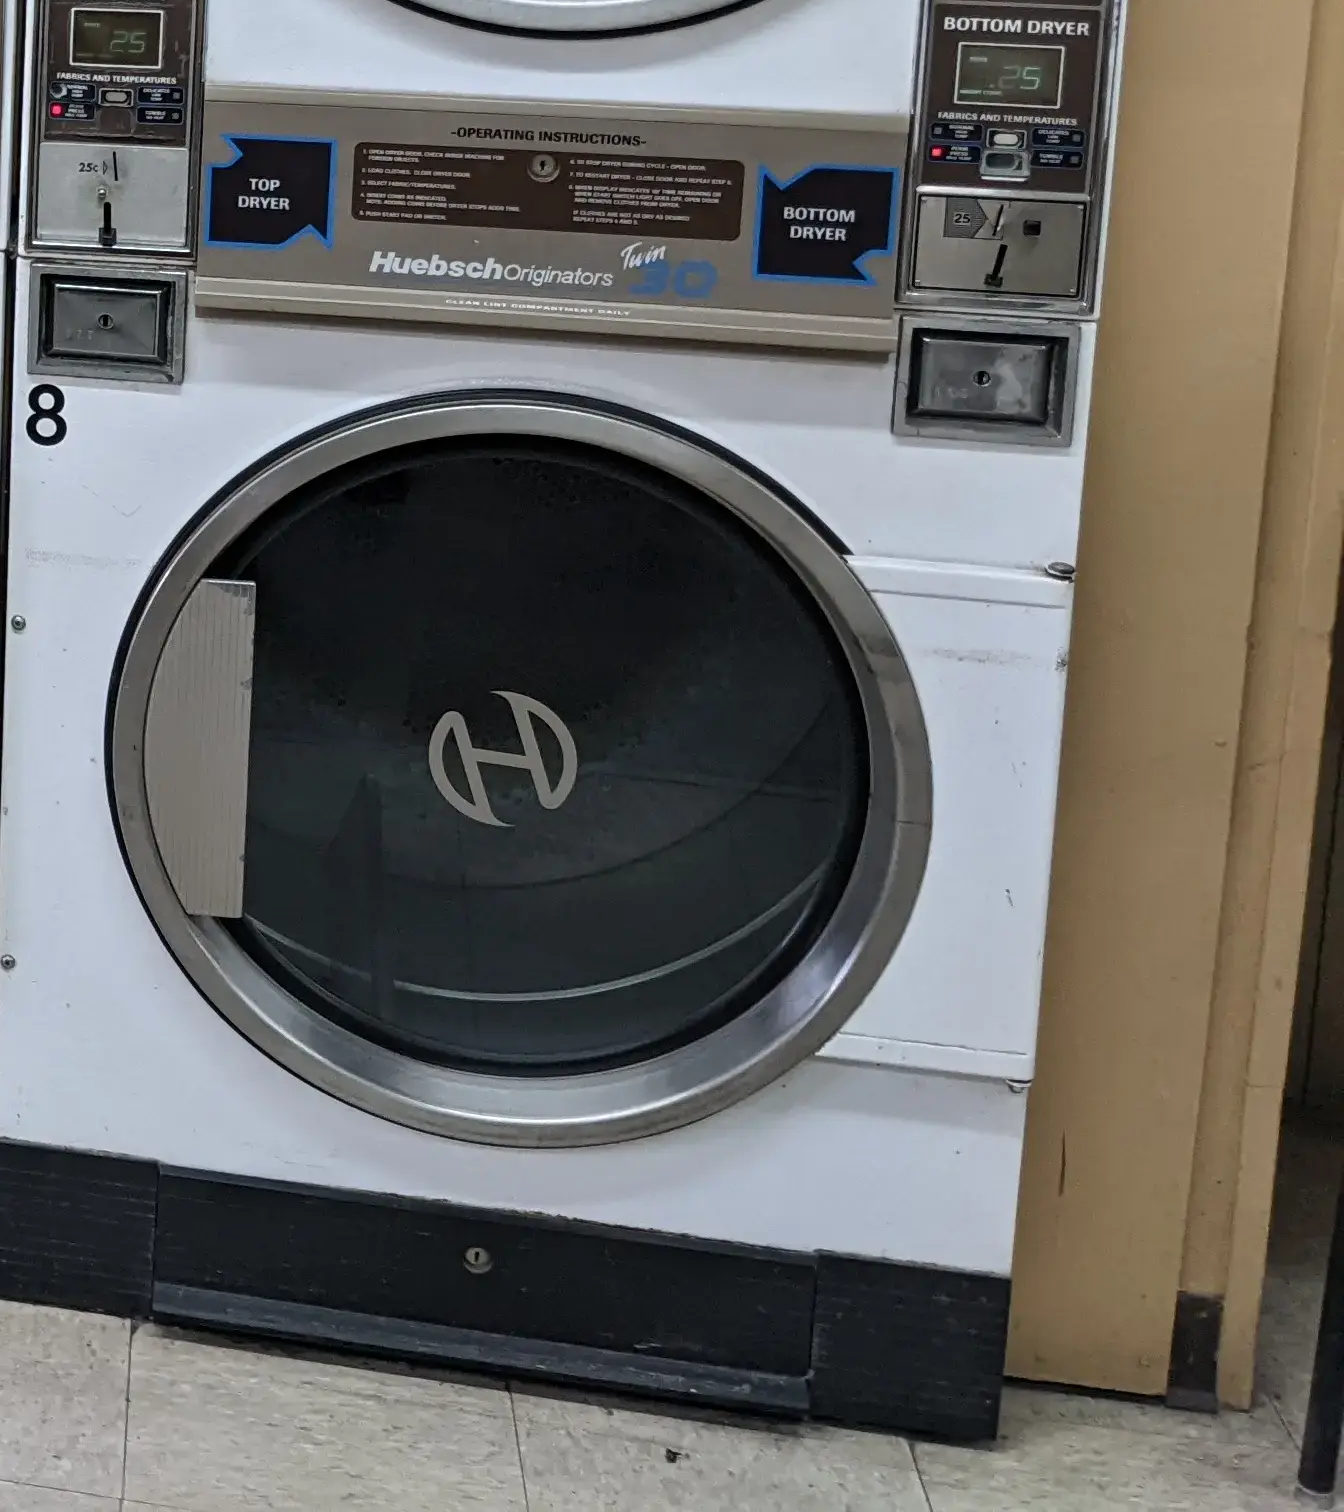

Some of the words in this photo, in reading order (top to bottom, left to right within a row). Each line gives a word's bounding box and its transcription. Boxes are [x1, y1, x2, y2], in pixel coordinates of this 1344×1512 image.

[943, 17, 1021, 34] BOTTOM
[1027, 19, 1089, 36] DRYER
[57, 72, 91, 81] FABRICS
[92, 74, 110, 82] AND
[112, 75, 177, 85] TEMPERATURES
[937, 111, 977, 121] FABRICS
[979, 113, 1000, 122] AND
[1003, 114, 1077, 125] TEMPERATURES
[249, 178, 280, 192] TOP
[238, 196, 290, 211] DRYER
[783, 206, 856, 223] BOTTOM
[954, 213, 970, 224] 25
[789, 225, 847, 242] DRYER
[620, 242, 666, 270] Twin
[26, 384, 67, 446] 8
